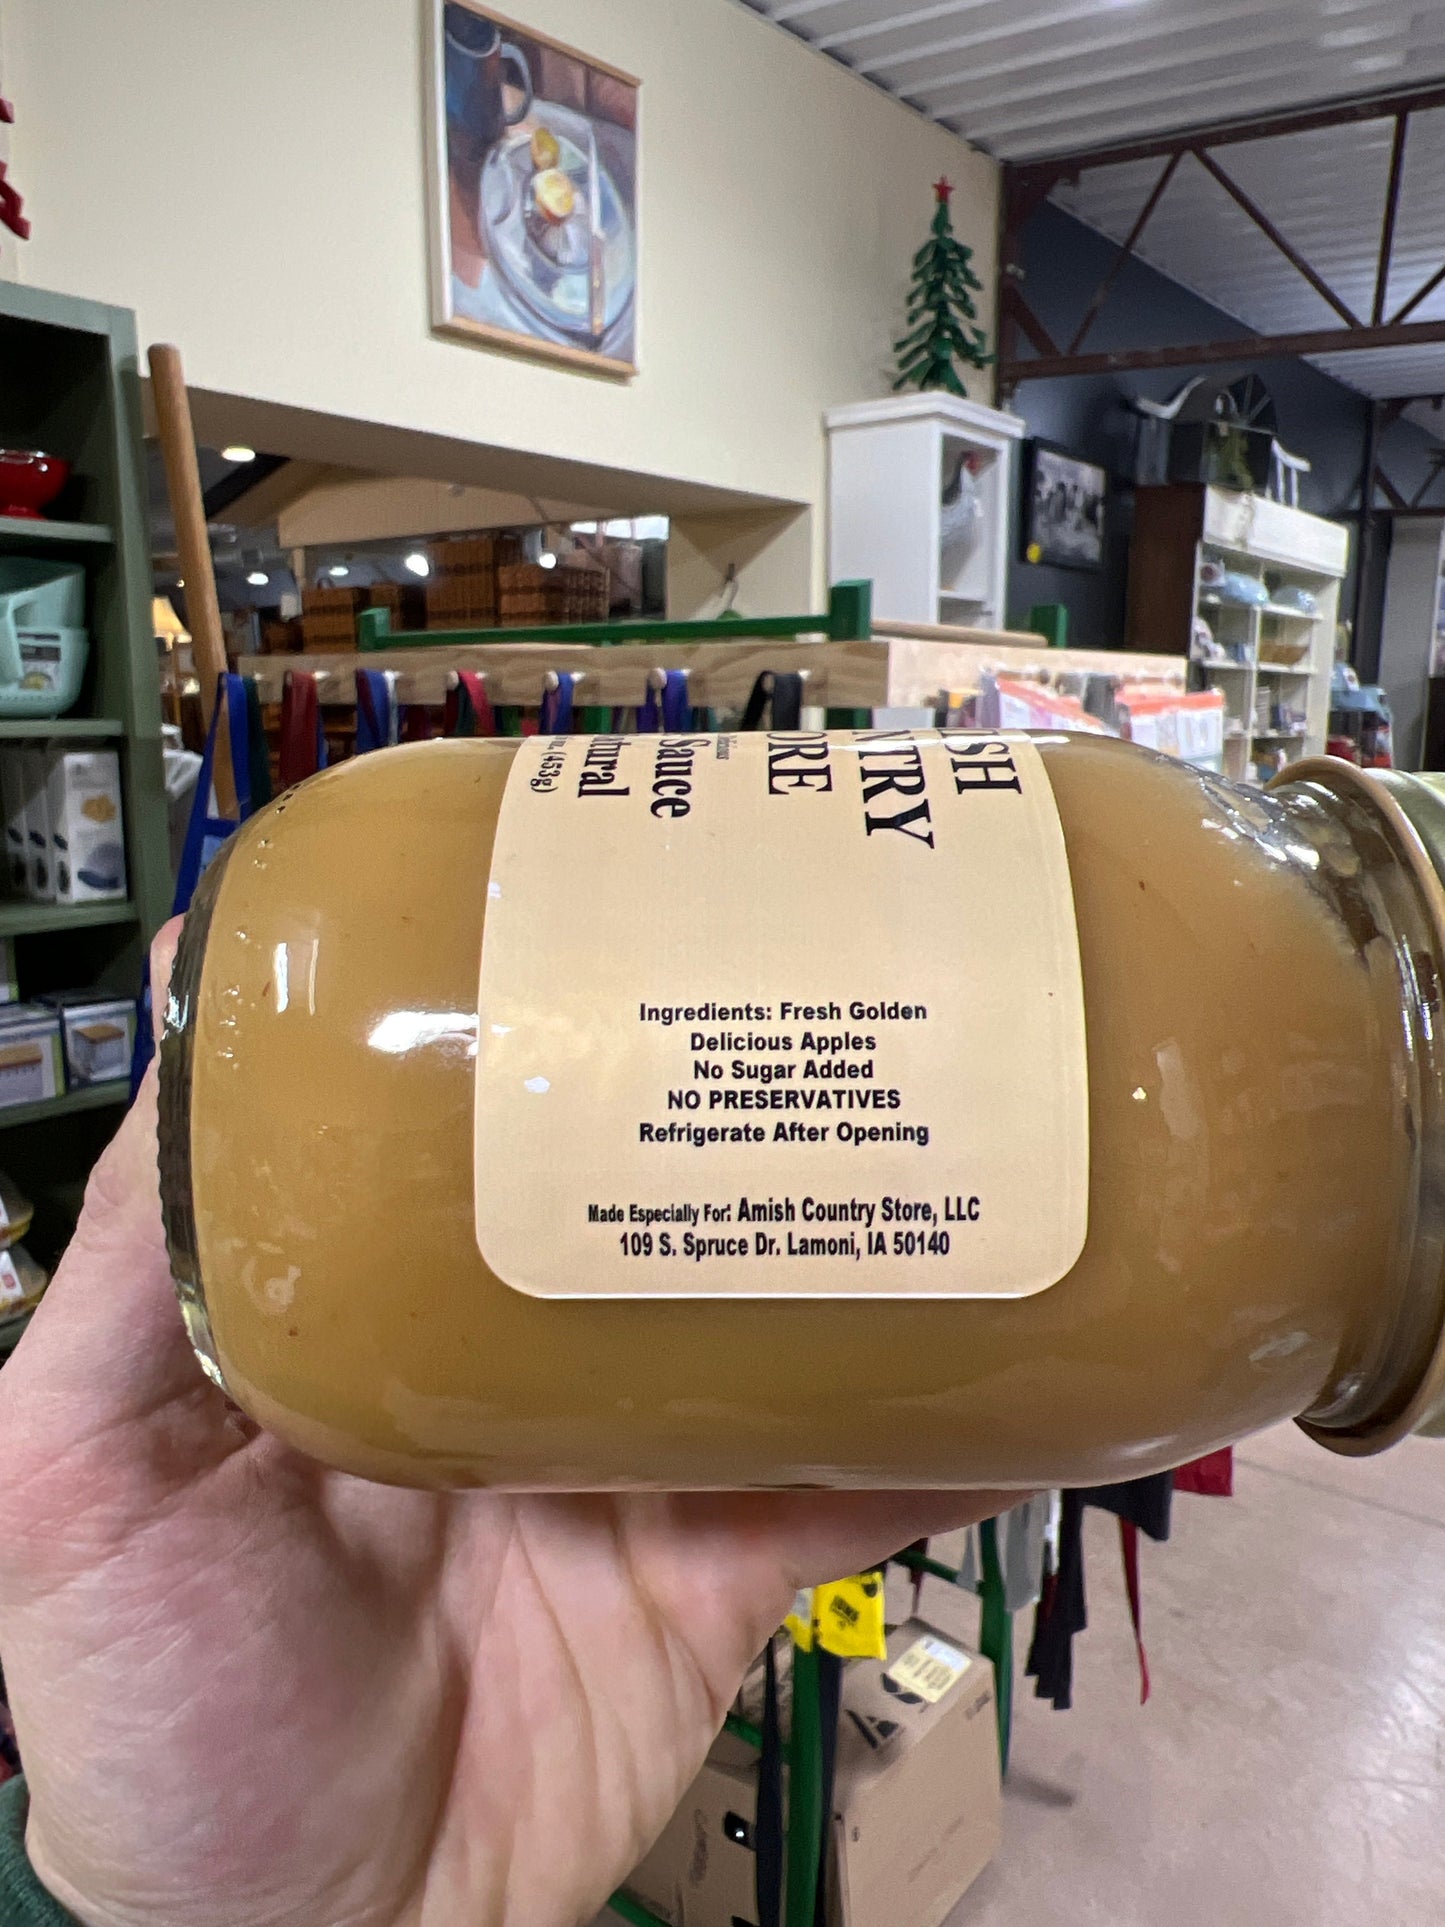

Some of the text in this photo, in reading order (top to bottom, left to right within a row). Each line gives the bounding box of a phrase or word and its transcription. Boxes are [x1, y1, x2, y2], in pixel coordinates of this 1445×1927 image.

[529, 751, 567, 793] (453g)
[650, 738, 712, 819] Sauce
[639, 1001, 927, 1026] Ingredients: Fresh Golden
[690, 1031, 877, 1056] Delicious Apples
[693, 1059, 874, 1085] No Sugar Added
[667, 1089, 901, 1110] NO PRESERVATIVES
[639, 1121, 929, 1148] Refrigerate After Opening
[588, 1203, 625, 1223] Made
[629, 1203, 700, 1228] Especially
[737, 1196, 796, 1223] Amish
[801, 1196, 876, 1229] Country
[881, 1196, 938, 1227] Store,
[944, 1196, 981, 1222] LLC
[619, 1230, 950, 1263] 109 S. Spruce Dr. Lamoni, IA 50140
